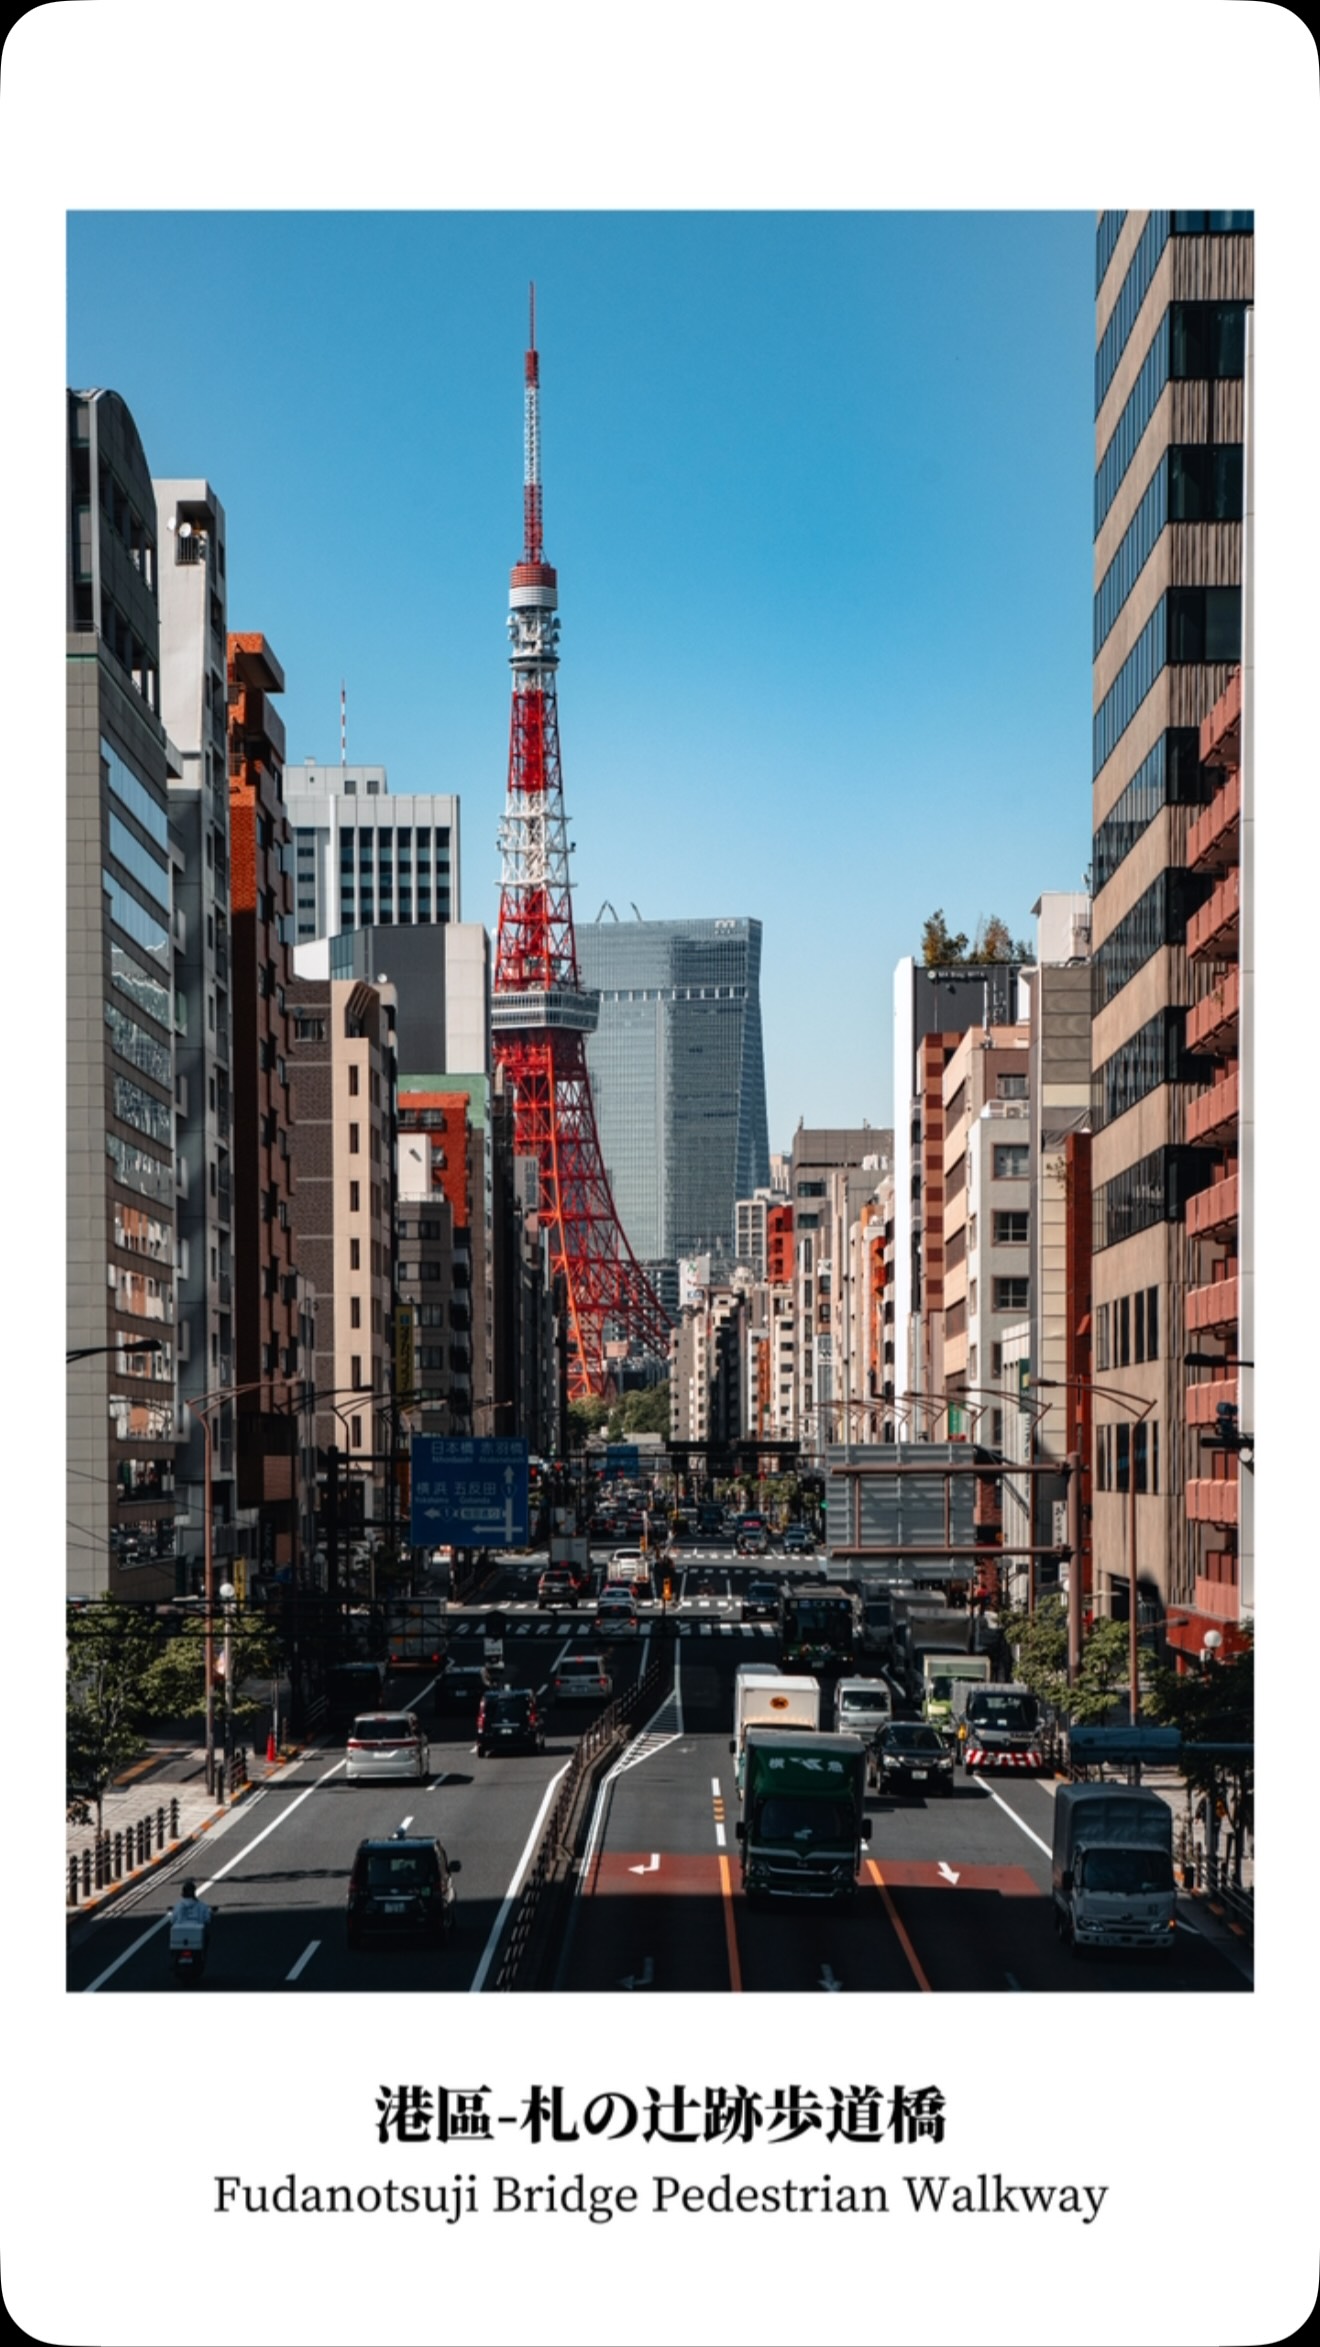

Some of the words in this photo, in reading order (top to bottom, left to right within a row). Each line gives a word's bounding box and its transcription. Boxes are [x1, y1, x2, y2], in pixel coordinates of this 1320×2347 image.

[431, 1440, 474, 1455] 日本橋
[480, 1441, 524, 1455] 赤羽橋
[416, 1481, 448, 1496] 横浜
[454, 1481, 497, 1496] 五反田
